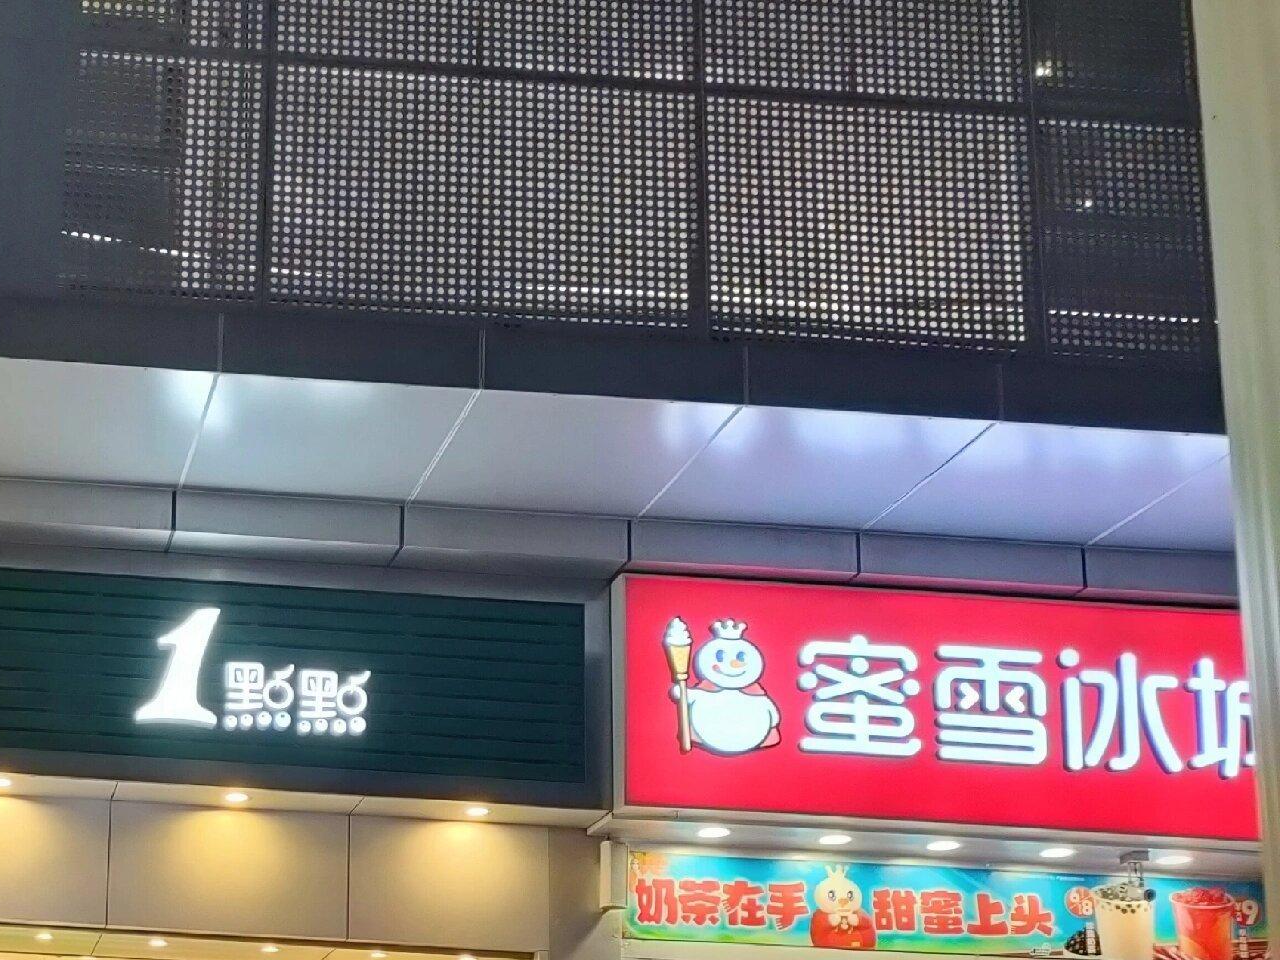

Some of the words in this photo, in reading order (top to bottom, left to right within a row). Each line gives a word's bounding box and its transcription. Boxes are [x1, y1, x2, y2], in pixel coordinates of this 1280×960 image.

[634, 877, 810, 930] 奶茶在手
[872, 887, 1058, 937] 甜蜜上头
